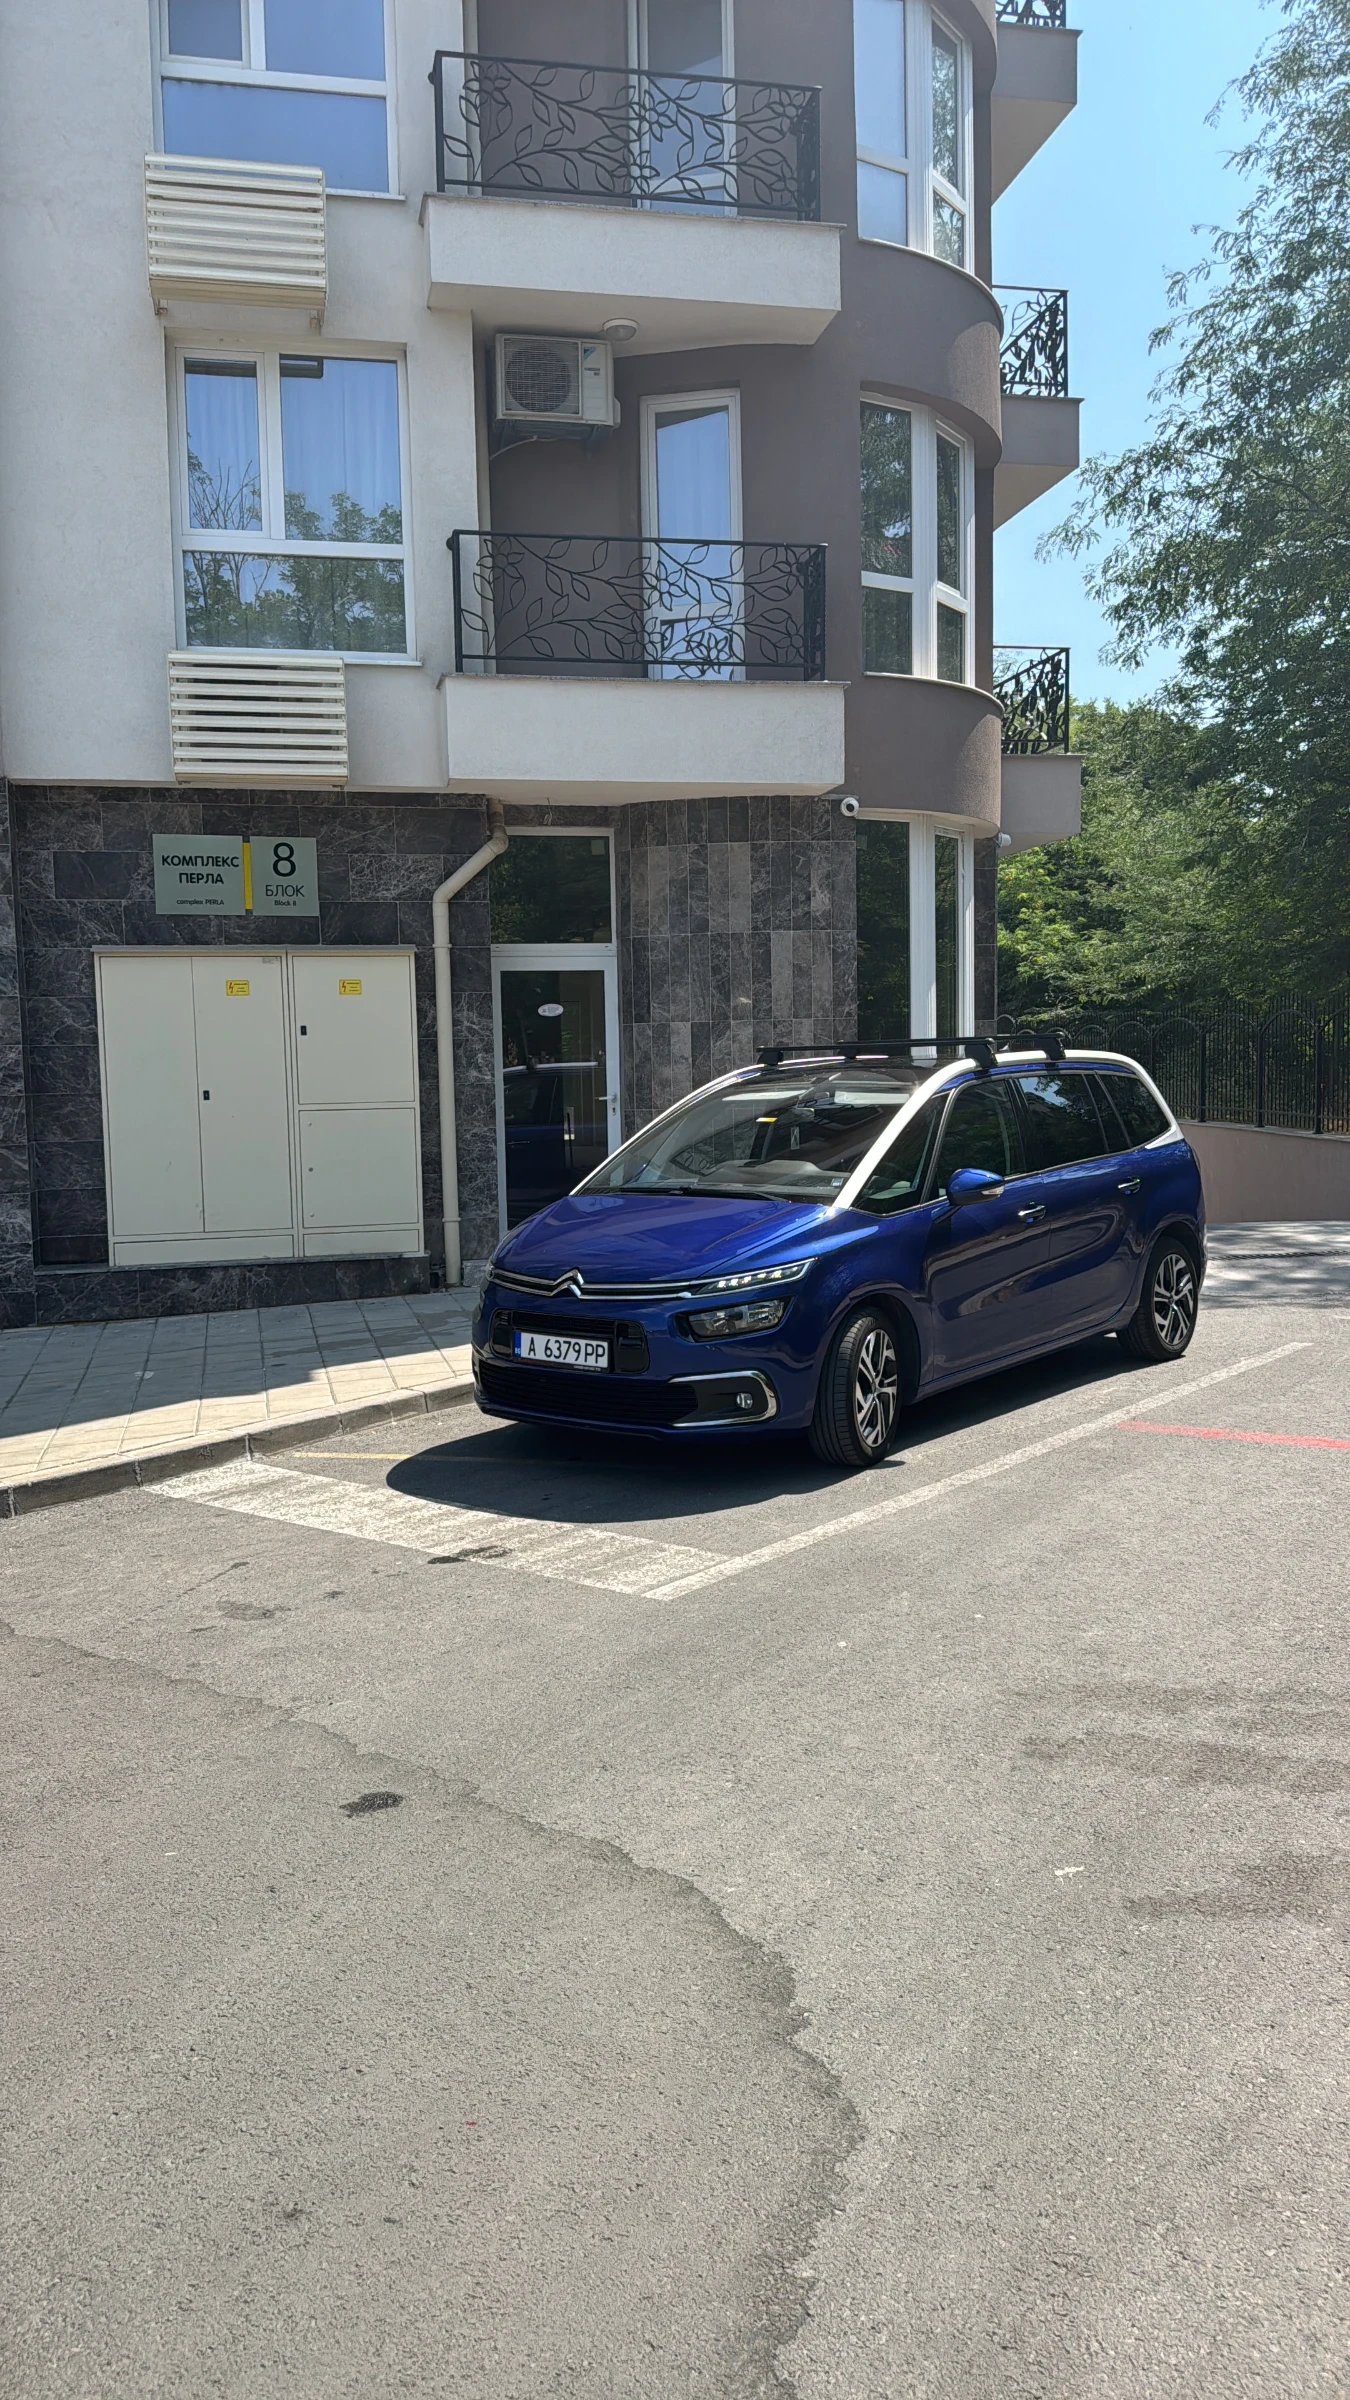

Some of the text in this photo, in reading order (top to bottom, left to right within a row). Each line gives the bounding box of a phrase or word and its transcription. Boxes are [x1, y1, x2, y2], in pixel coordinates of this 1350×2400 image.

[161, 855, 240, 868] КОМПЛЕКС
[272, 842, 296, 877] 8
[178, 873, 224, 884] ПЕРЛА
[265, 884, 305, 897] БЛОК
